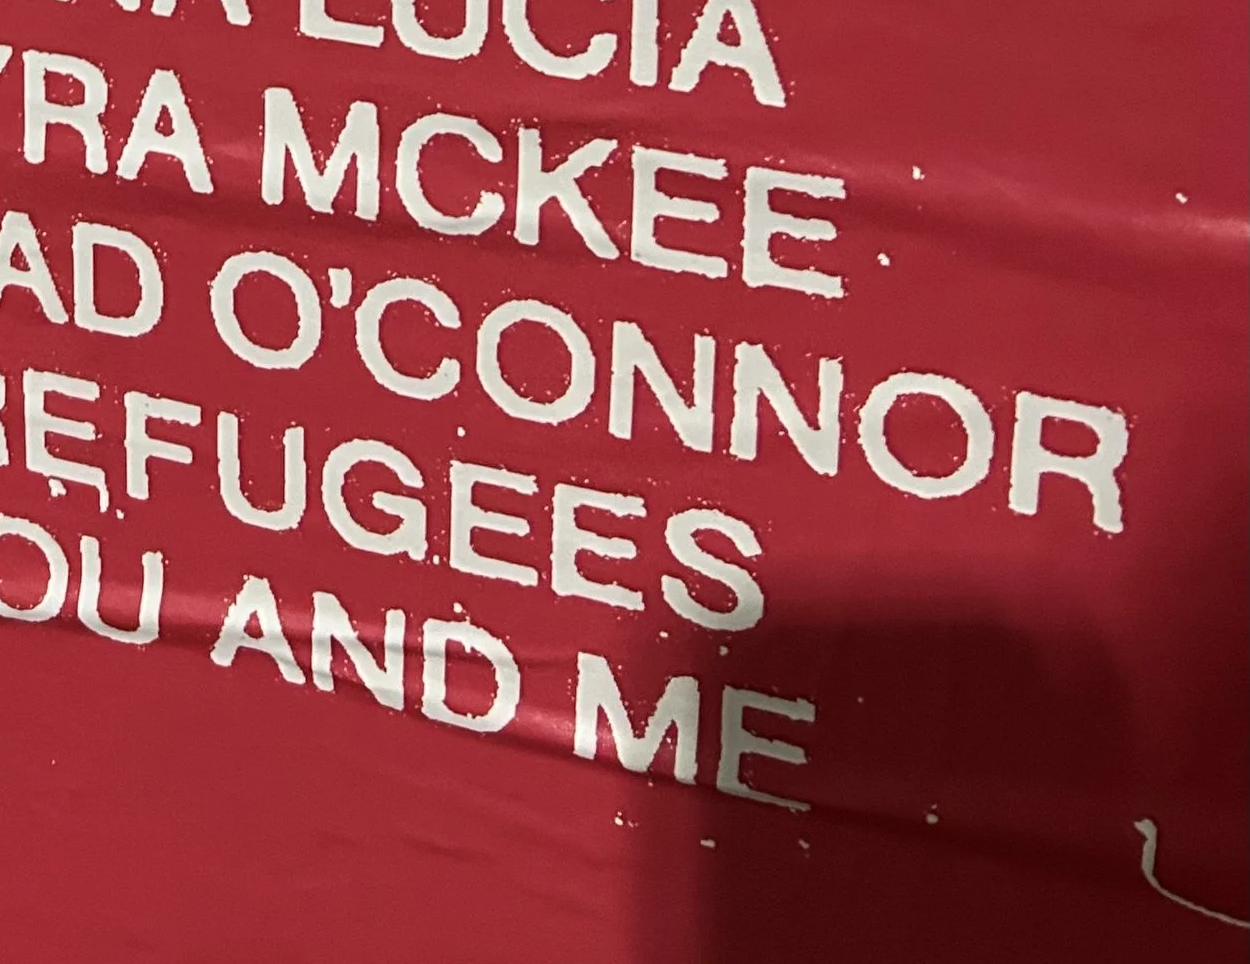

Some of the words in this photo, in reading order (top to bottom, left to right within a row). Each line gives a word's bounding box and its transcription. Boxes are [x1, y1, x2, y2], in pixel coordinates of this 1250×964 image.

[262, 87, 846, 299] MCKEE
[210, 251, 1129, 533] O'CONNOR
[210, 575, 520, 732] AND
[573, 652, 816, 814] ME
